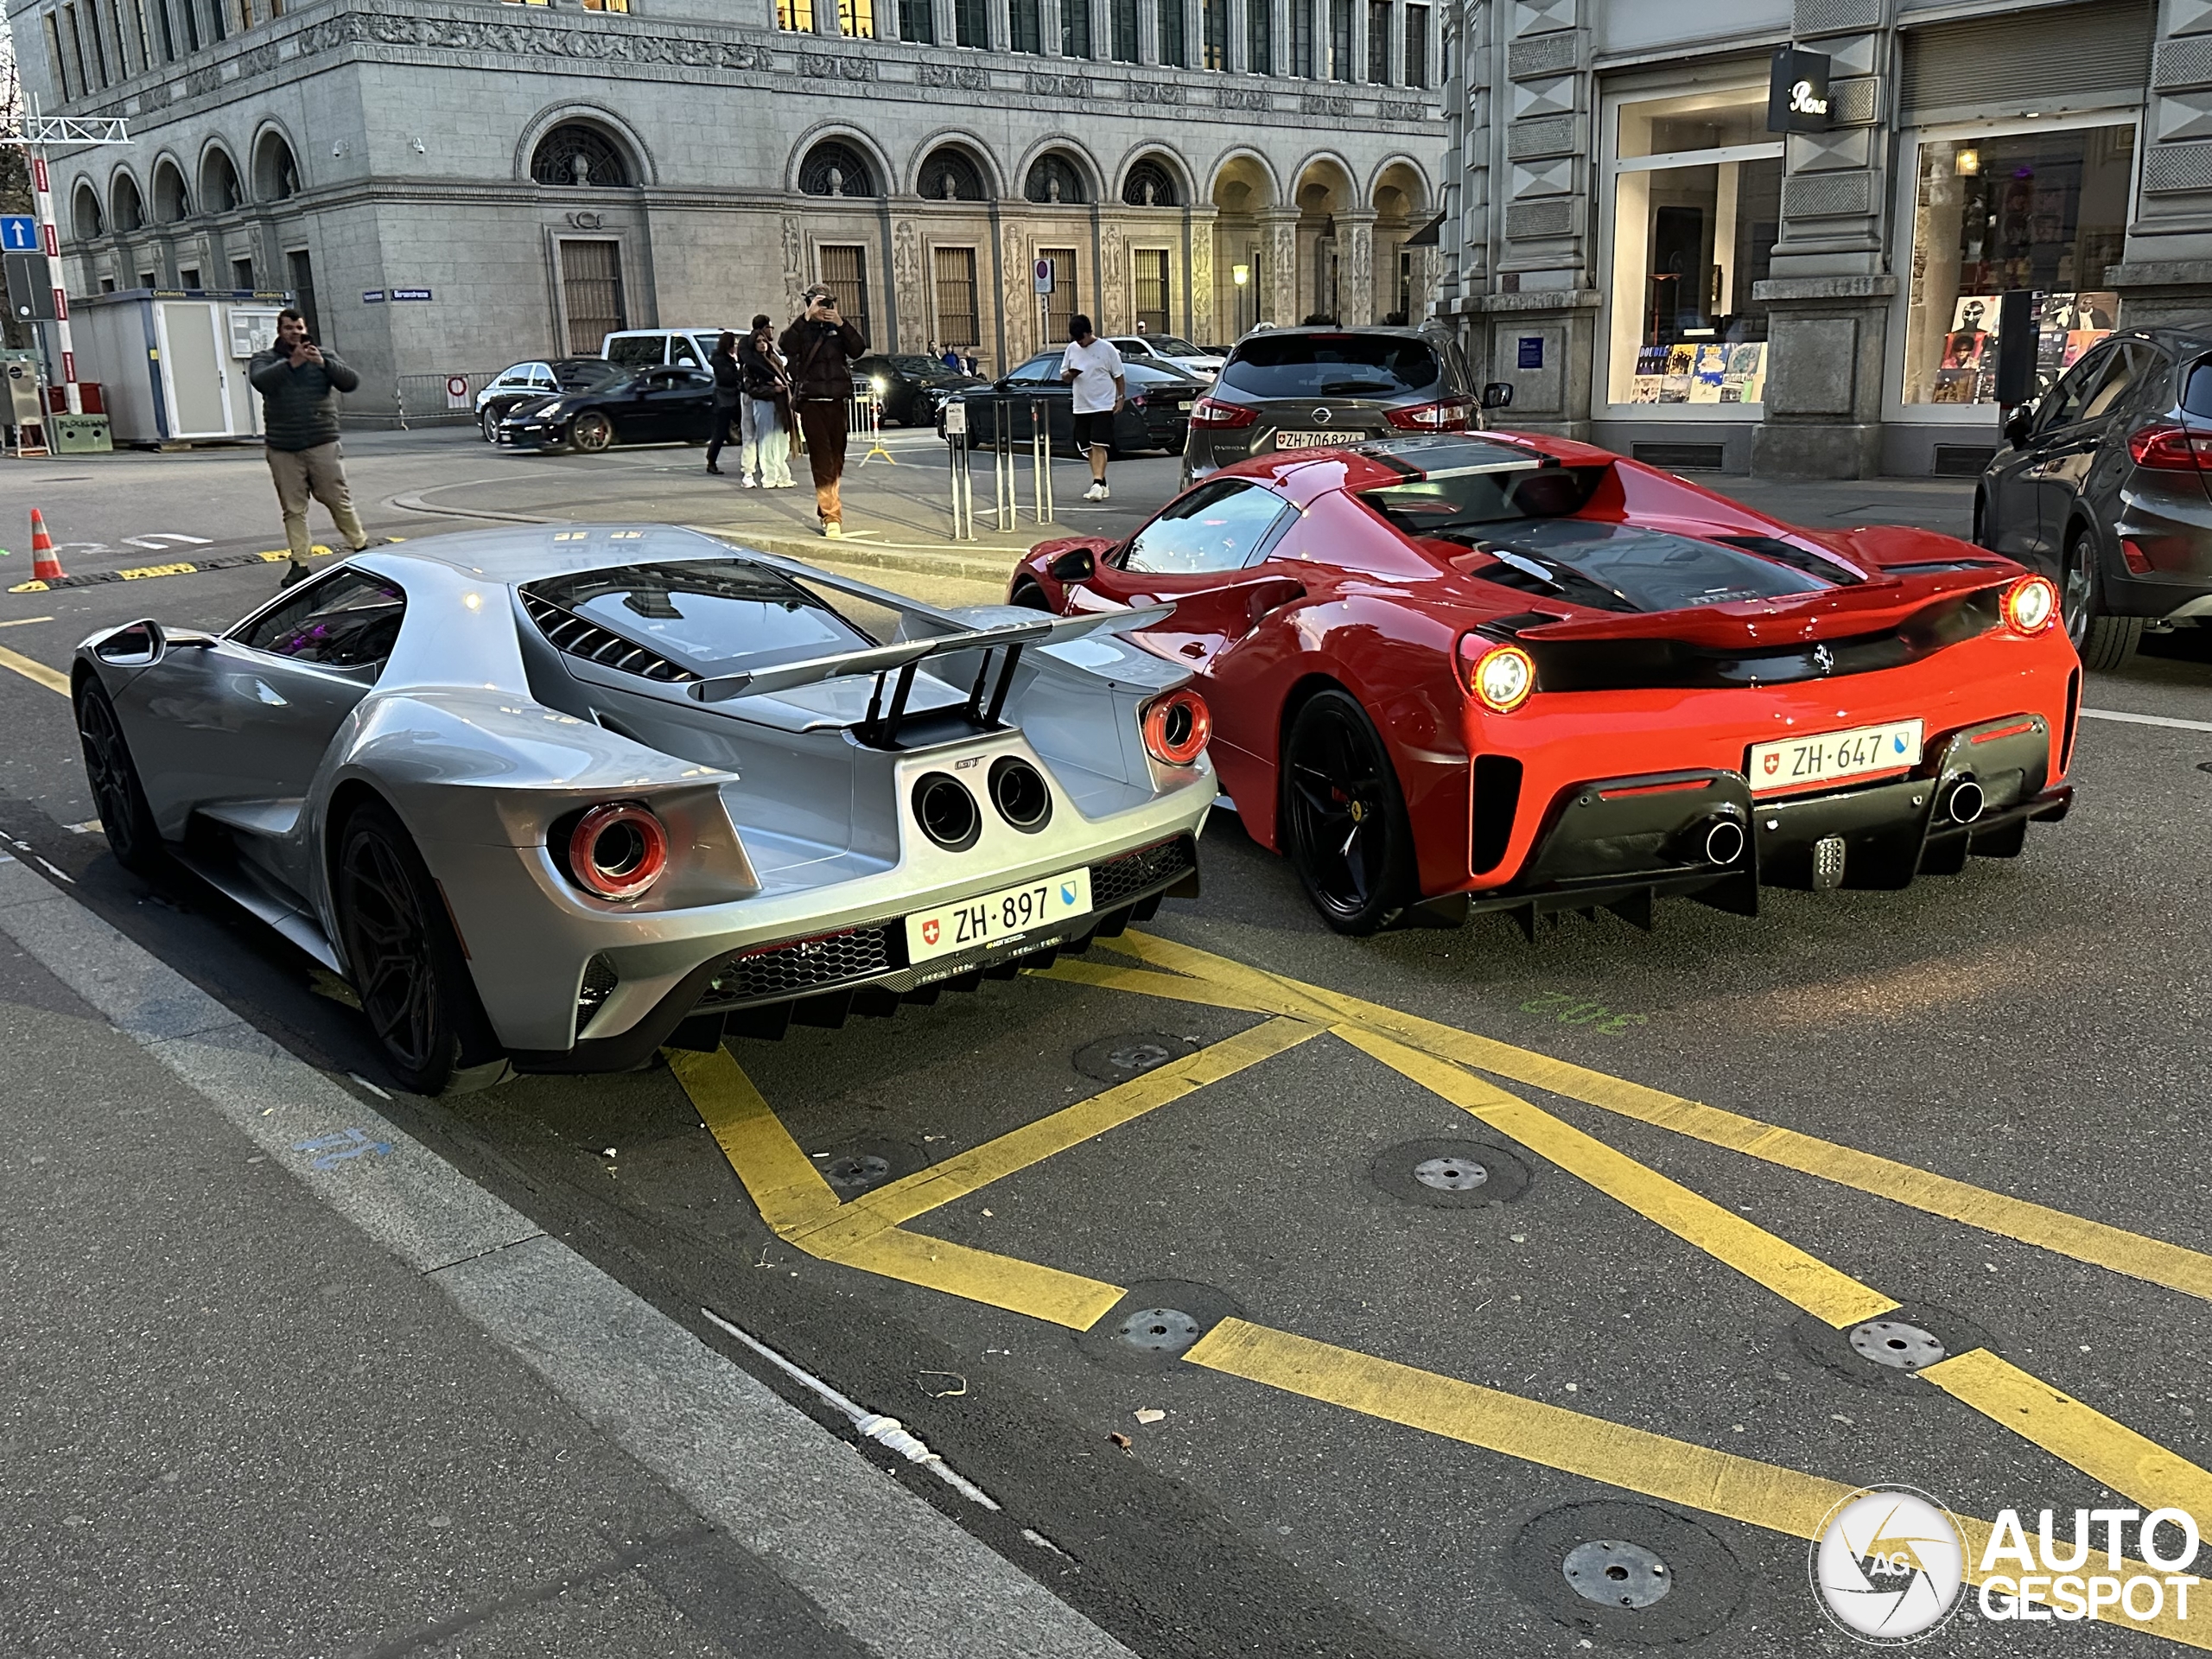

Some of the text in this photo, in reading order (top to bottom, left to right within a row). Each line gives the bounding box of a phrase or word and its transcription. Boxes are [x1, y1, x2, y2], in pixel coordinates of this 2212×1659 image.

[1789, 80, 1827, 114] Rena
[1791, 734, 1883, 776] ZH·647
[953, 887, 1047, 944] ZH·897
